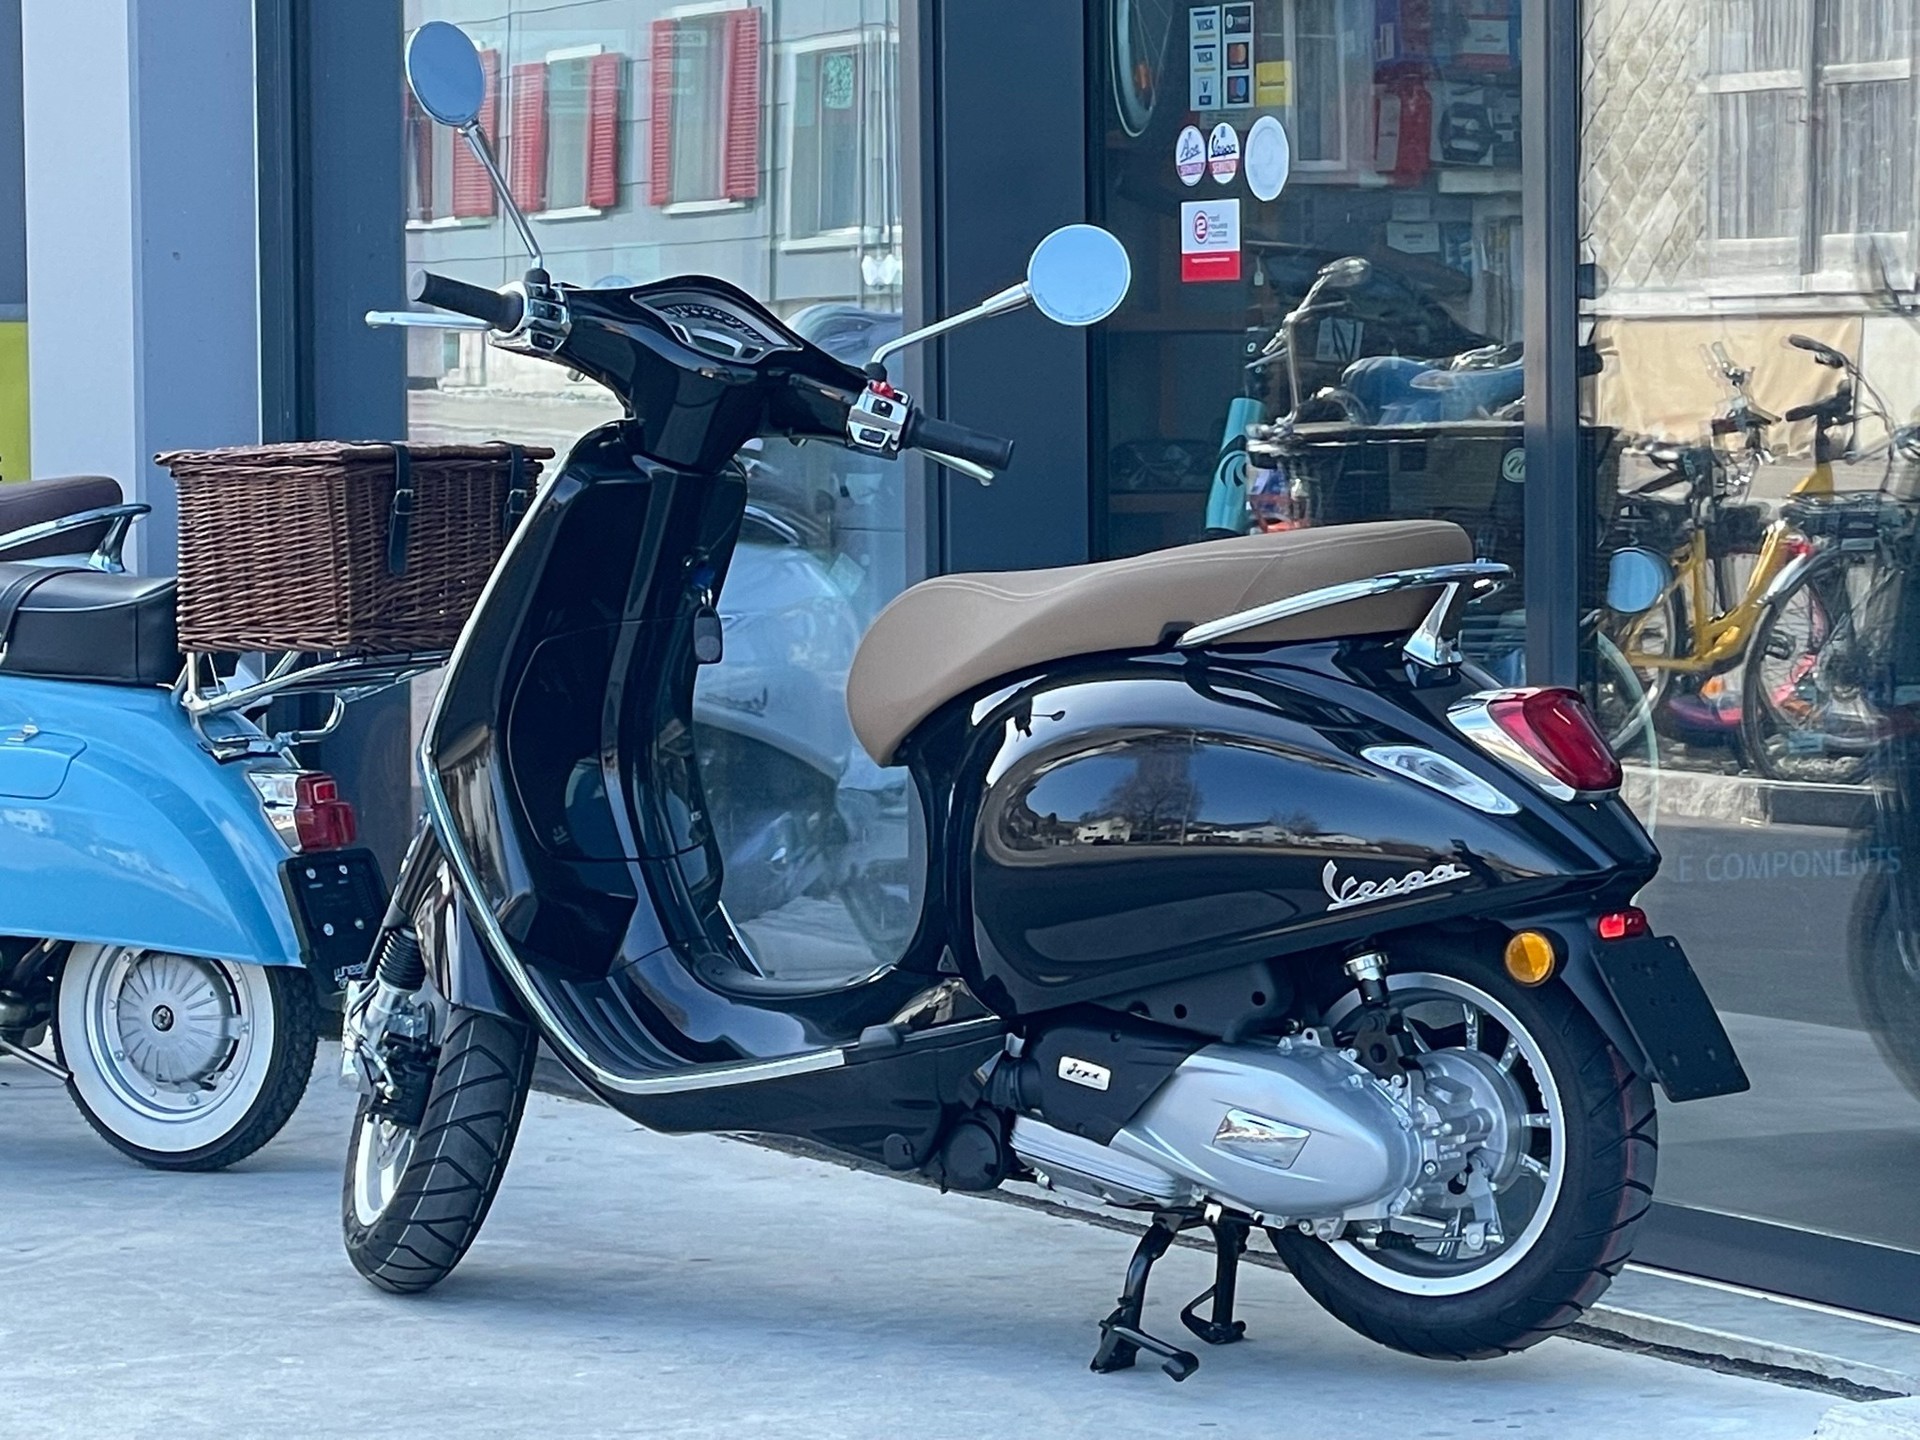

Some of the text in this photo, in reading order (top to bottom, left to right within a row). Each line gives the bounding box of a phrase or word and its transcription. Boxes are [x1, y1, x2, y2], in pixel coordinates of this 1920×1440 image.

[1196, 18, 1214, 31] VISA
[1196, 51, 1213, 63] VISA
[1210, 134, 1237, 158] Vespa
[1705, 847, 1902, 882] COMPONENTS
[1322, 859, 1471, 912] Vespa
